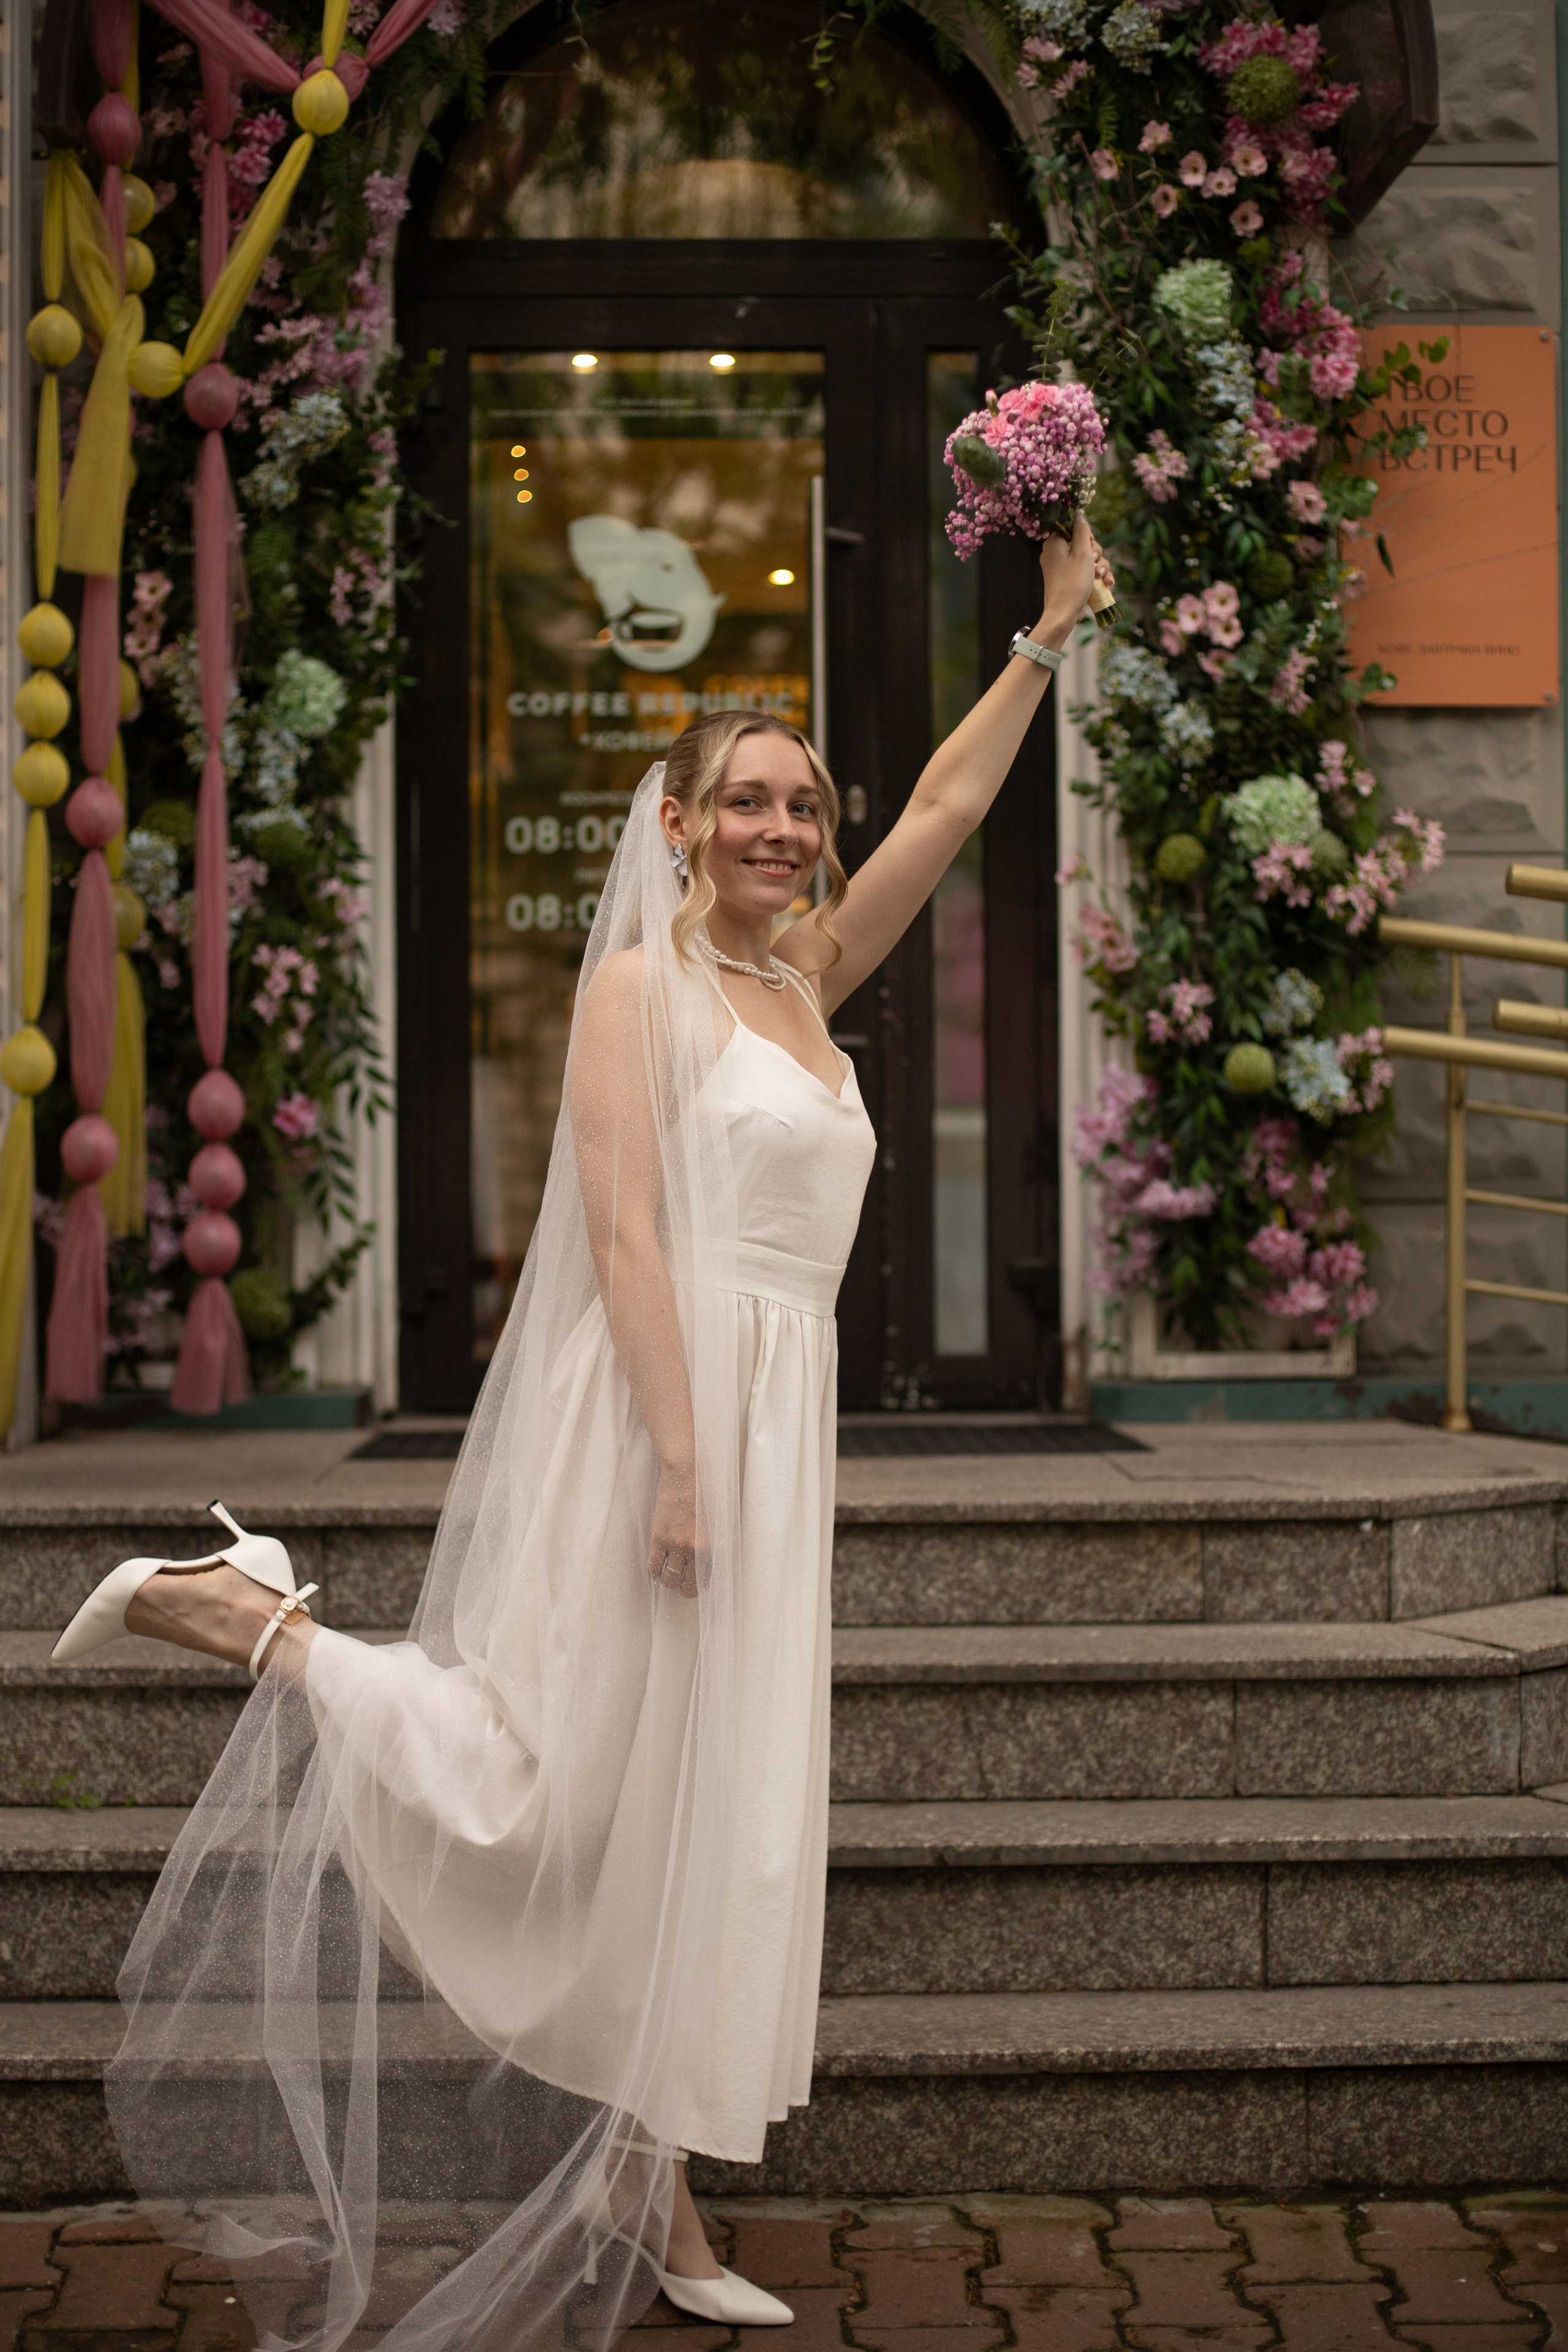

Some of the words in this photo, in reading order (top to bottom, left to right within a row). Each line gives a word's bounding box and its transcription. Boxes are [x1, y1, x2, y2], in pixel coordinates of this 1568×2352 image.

[507, 692, 630, 716] COFFEE
[638, 692, 794, 715] REPUBLIC
[506, 892, 603, 932] 08:0
